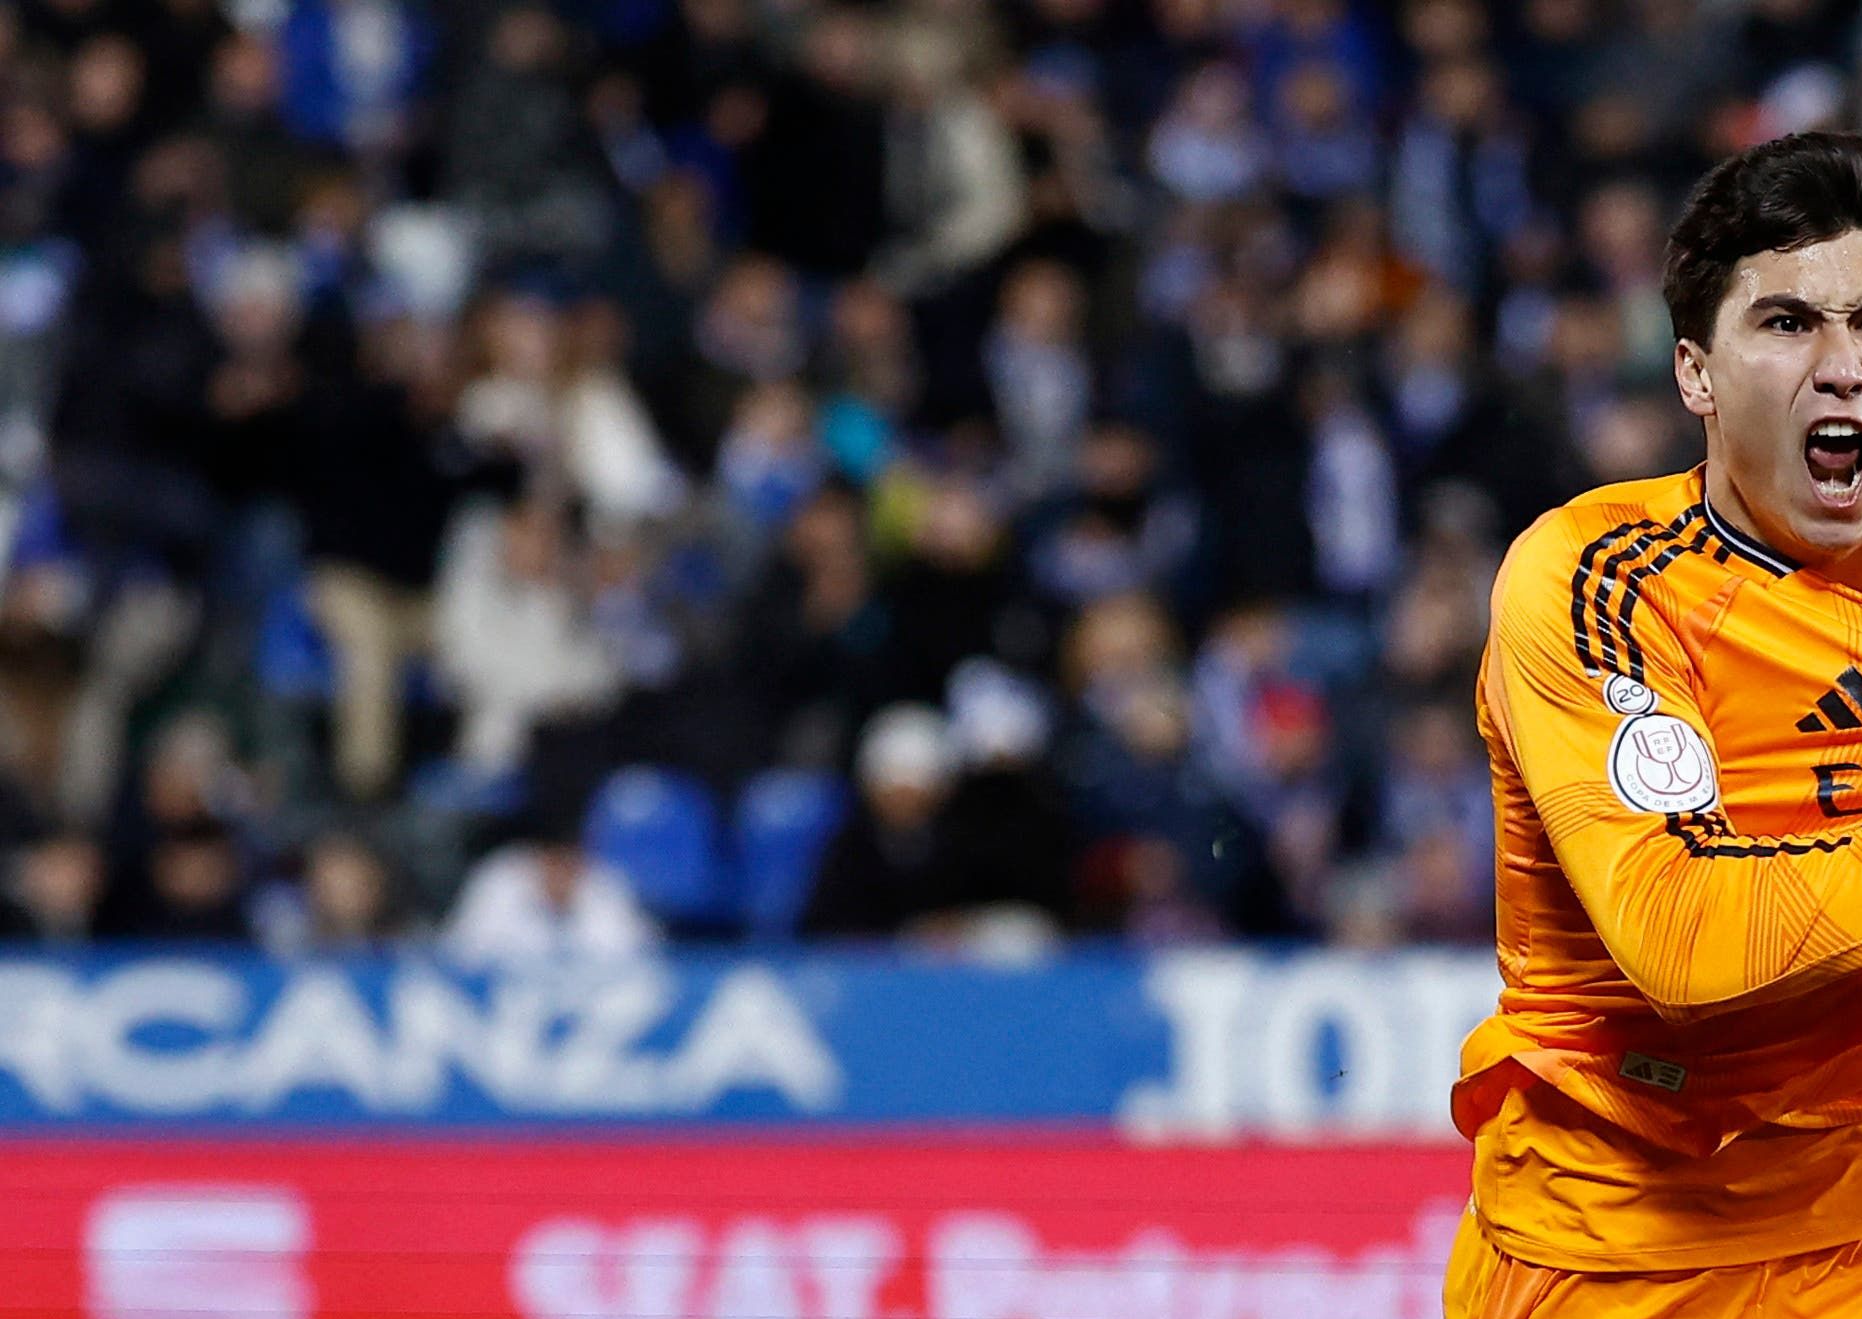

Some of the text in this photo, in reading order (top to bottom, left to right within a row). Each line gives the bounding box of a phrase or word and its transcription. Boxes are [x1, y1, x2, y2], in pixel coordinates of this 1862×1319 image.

[1616, 684, 1645, 704] 20
[1626, 774, 1650, 802] COPA
[1654, 798, 1670, 808] DE
[1115, 945, 1500, 1145] JO
